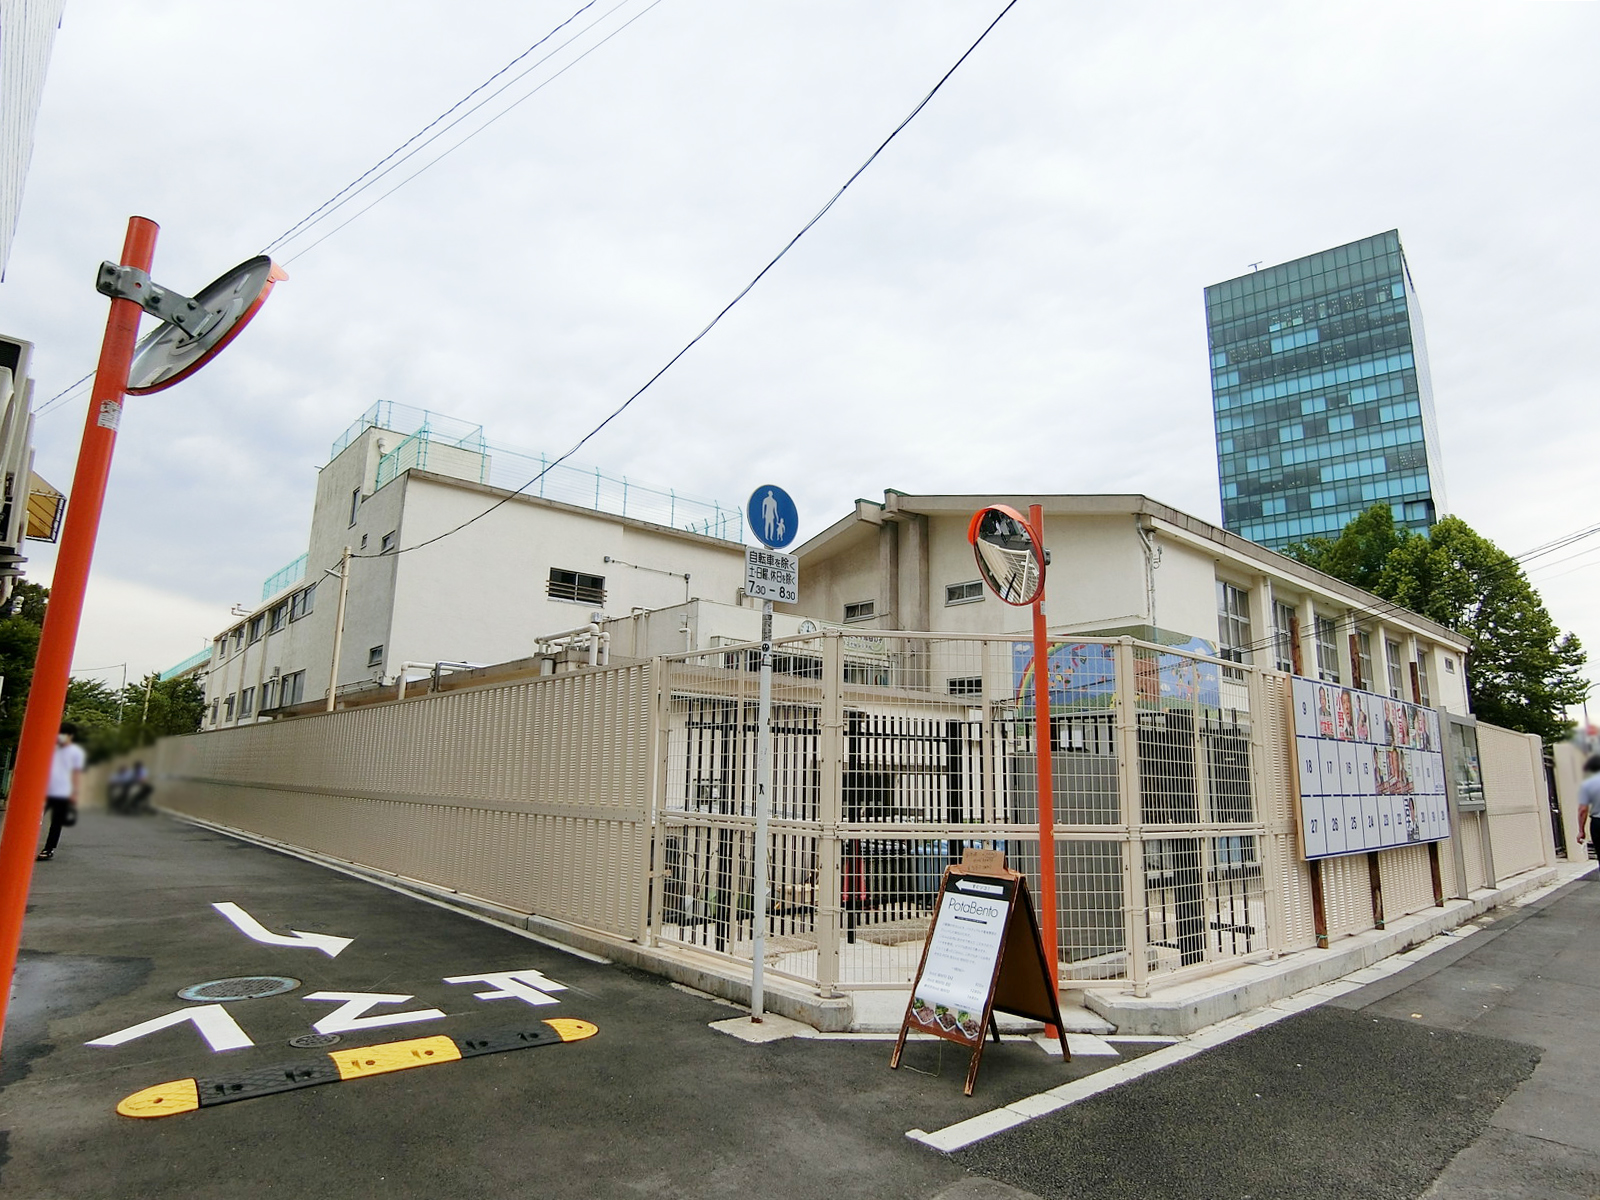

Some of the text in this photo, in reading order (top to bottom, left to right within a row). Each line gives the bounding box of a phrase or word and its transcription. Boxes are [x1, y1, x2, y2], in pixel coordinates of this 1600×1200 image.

[749, 550, 796, 571] 自転車を除く
[1301, 702, 1308, 715] 9
[1305, 759, 1313, 774] 18
[1326, 760, 1333, 775] 17
[1310, 818, 1318, 834] 27
[1331, 817, 1339, 832] 26
[948, 896, 999, 918] PotaBento
